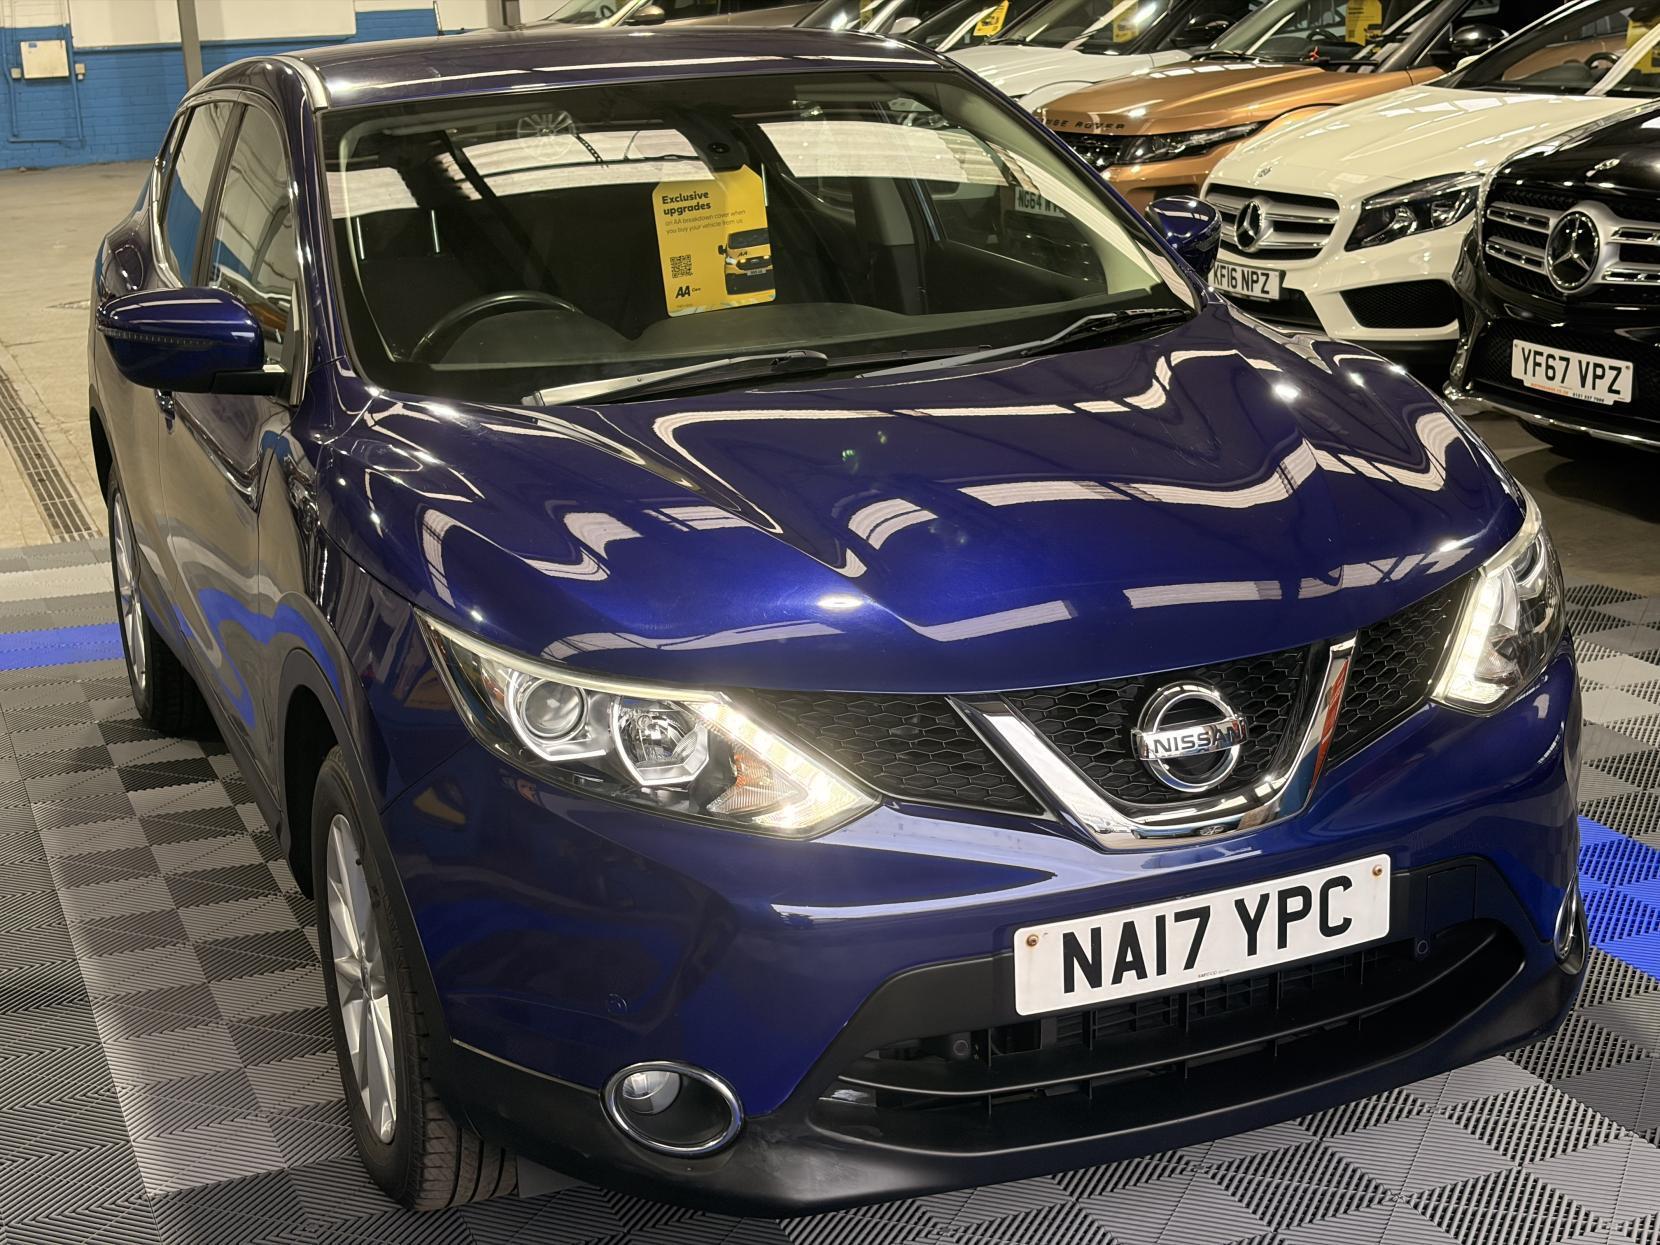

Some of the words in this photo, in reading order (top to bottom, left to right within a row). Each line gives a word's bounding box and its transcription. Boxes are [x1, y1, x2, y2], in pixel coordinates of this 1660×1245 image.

[662, 191, 709, 204] Exclusive
[663, 202, 711, 216] upgrades
[683, 214, 713, 224] breakdown
[730, 209, 746, 217] when
[1213, 263, 1238, 289] KF16
[1241, 269, 1270, 295] NPZ
[675, 285, 690, 299] AA
[1521, 346, 1571, 384] YF67
[1578, 359, 1622, 395] VPZ
[1153, 726, 1240, 754] NISSAN
[1062, 905, 1211, 994] NA17
[1234, 875, 1353, 957] YPC
